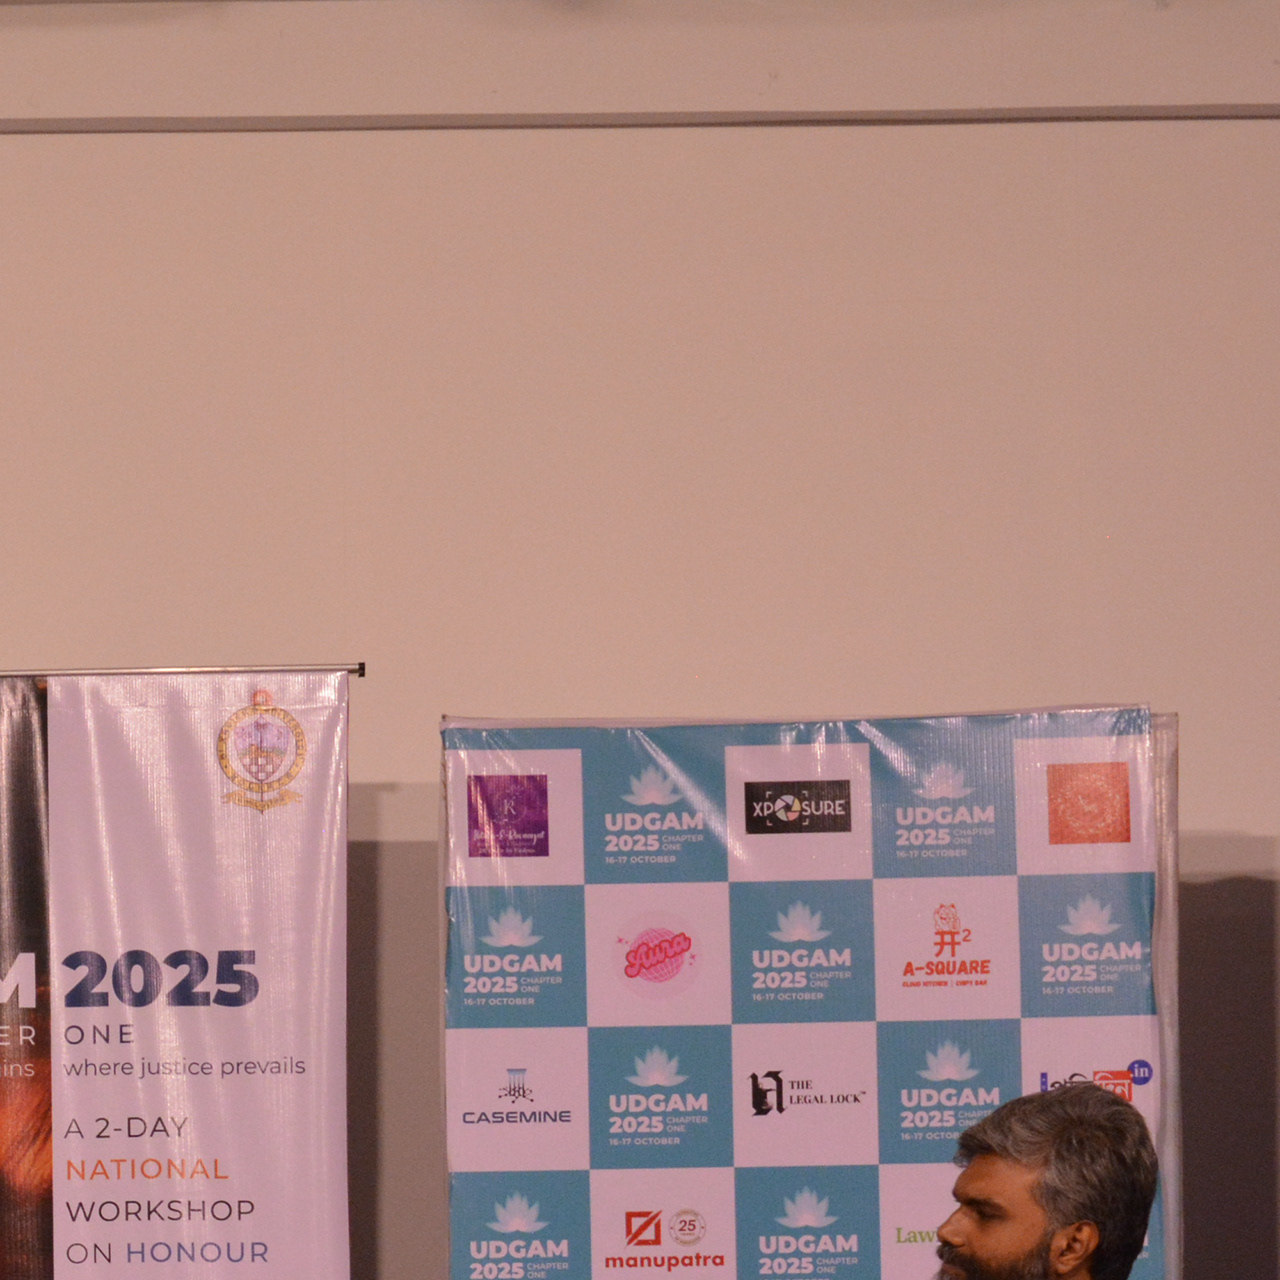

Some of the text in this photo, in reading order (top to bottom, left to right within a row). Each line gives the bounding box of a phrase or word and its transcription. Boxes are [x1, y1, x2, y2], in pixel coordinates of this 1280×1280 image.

[61, 949, 259, 1008] 2025
[903, 960, 990, 976] A-SQUARE
[65, 1024, 131, 1045] ONE
[66, 1059, 133, 1076] where
[139, 1057, 213, 1079] justice
[221, 1057, 305, 1079] prevails
[789, 1080, 812, 1089] THE
[790, 1095, 827, 1105] LEGAL
[64, 1117, 187, 1139] A 2-DAY
[463, 1111, 571, 1124] CASEMINE
[67, 1158, 229, 1180] NATIONAL
[66, 1200, 254, 1222] WORKSHOP
[678, 1220, 696, 1231] 25
[67, 1242, 268, 1264] ON HONOUR
[605, 1253, 724, 1272] manupatra
